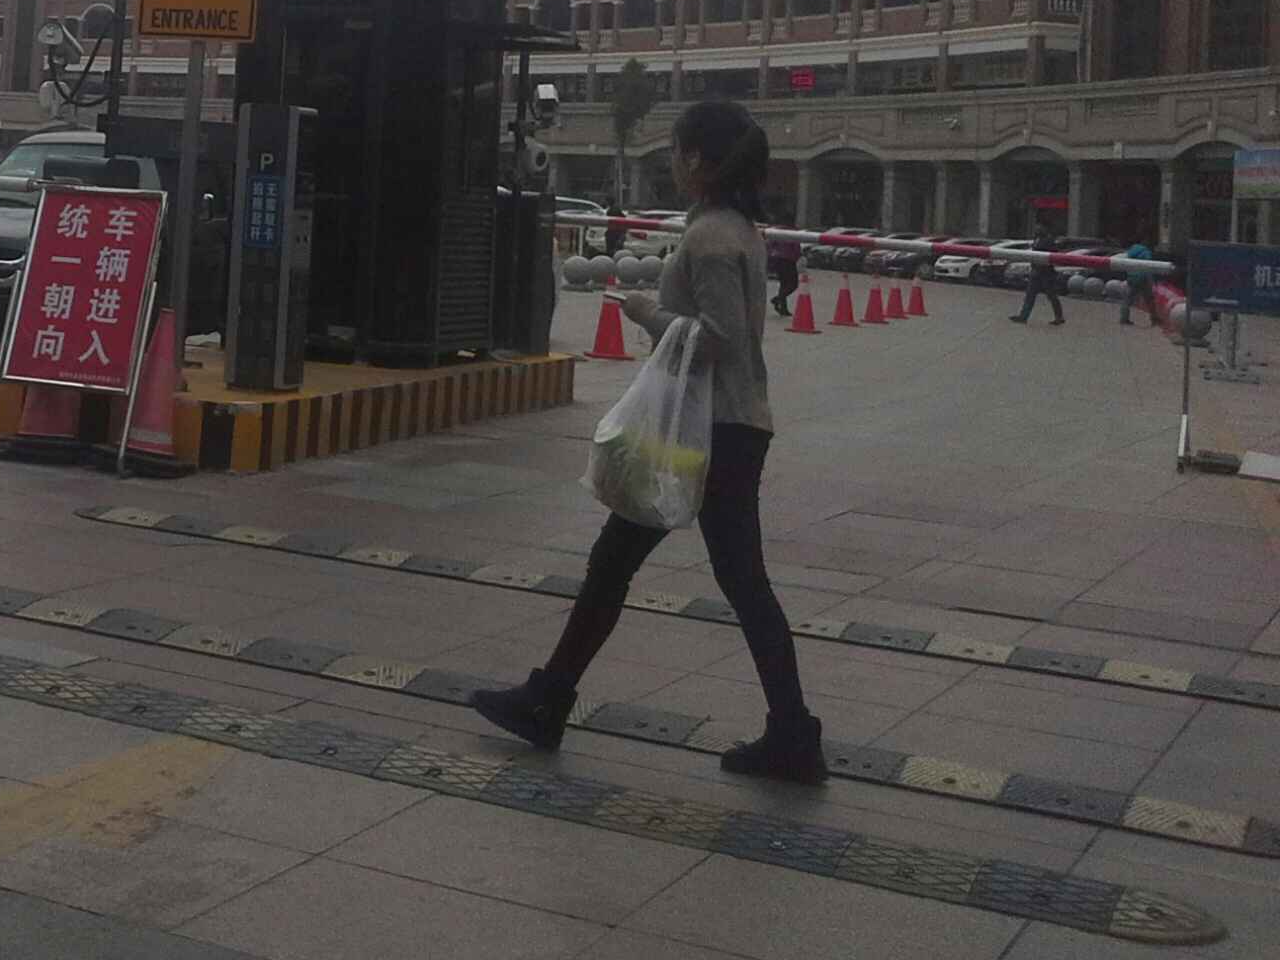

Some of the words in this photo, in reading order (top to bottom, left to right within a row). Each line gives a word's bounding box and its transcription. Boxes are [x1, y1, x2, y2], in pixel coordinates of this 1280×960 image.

[150, 6, 239, 33] ENTRANCE
[260, 152, 274, 171] P
[32, 204, 92, 362] 统一朝向
[78, 205, 138, 366] 车辆进入
